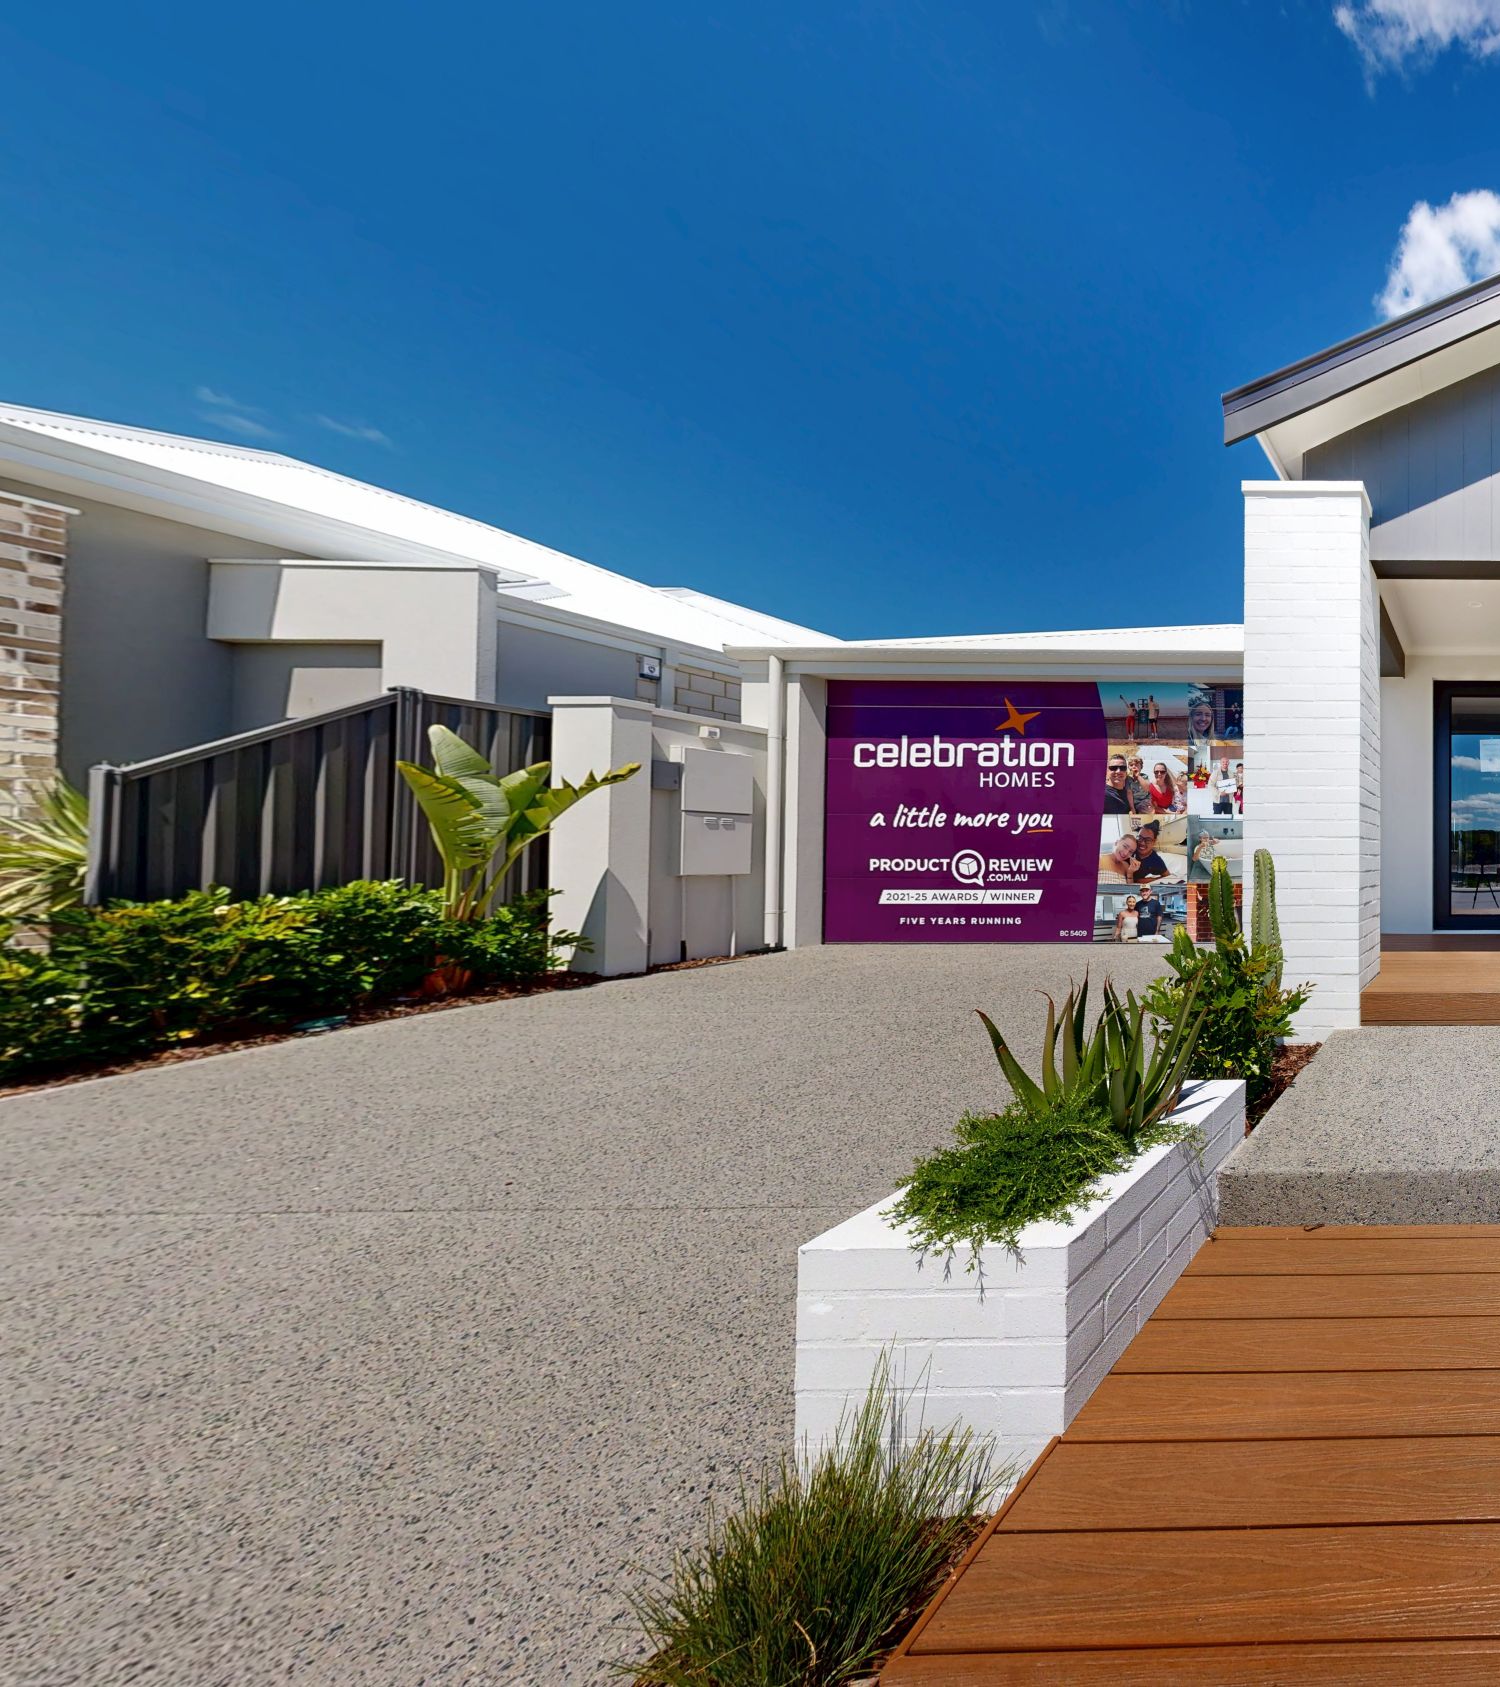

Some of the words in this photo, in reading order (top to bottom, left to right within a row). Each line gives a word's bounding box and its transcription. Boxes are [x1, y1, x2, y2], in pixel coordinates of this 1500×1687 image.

[853, 734, 1075, 768] celebration
[979, 771, 1056, 788] HOMES
[869, 812, 886, 828] a
[892, 803, 948, 828] little
[953, 812, 1010, 828] more
[1010, 812, 1054, 835] you
[869, 858, 951, 872] PRODUCT
[988, 858, 1054, 872] REVIEW
[986, 873, 1029, 882] .COM.AU
[885, 892, 928, 902] 2021-25
[931, 892, 979, 901] AWARDS
[990, 892, 1036, 901] WINNER
[899, 917, 926, 925] FIVE
[929, 916, 966, 925] YEARS
[970, 916, 1022, 925] RUNNING
